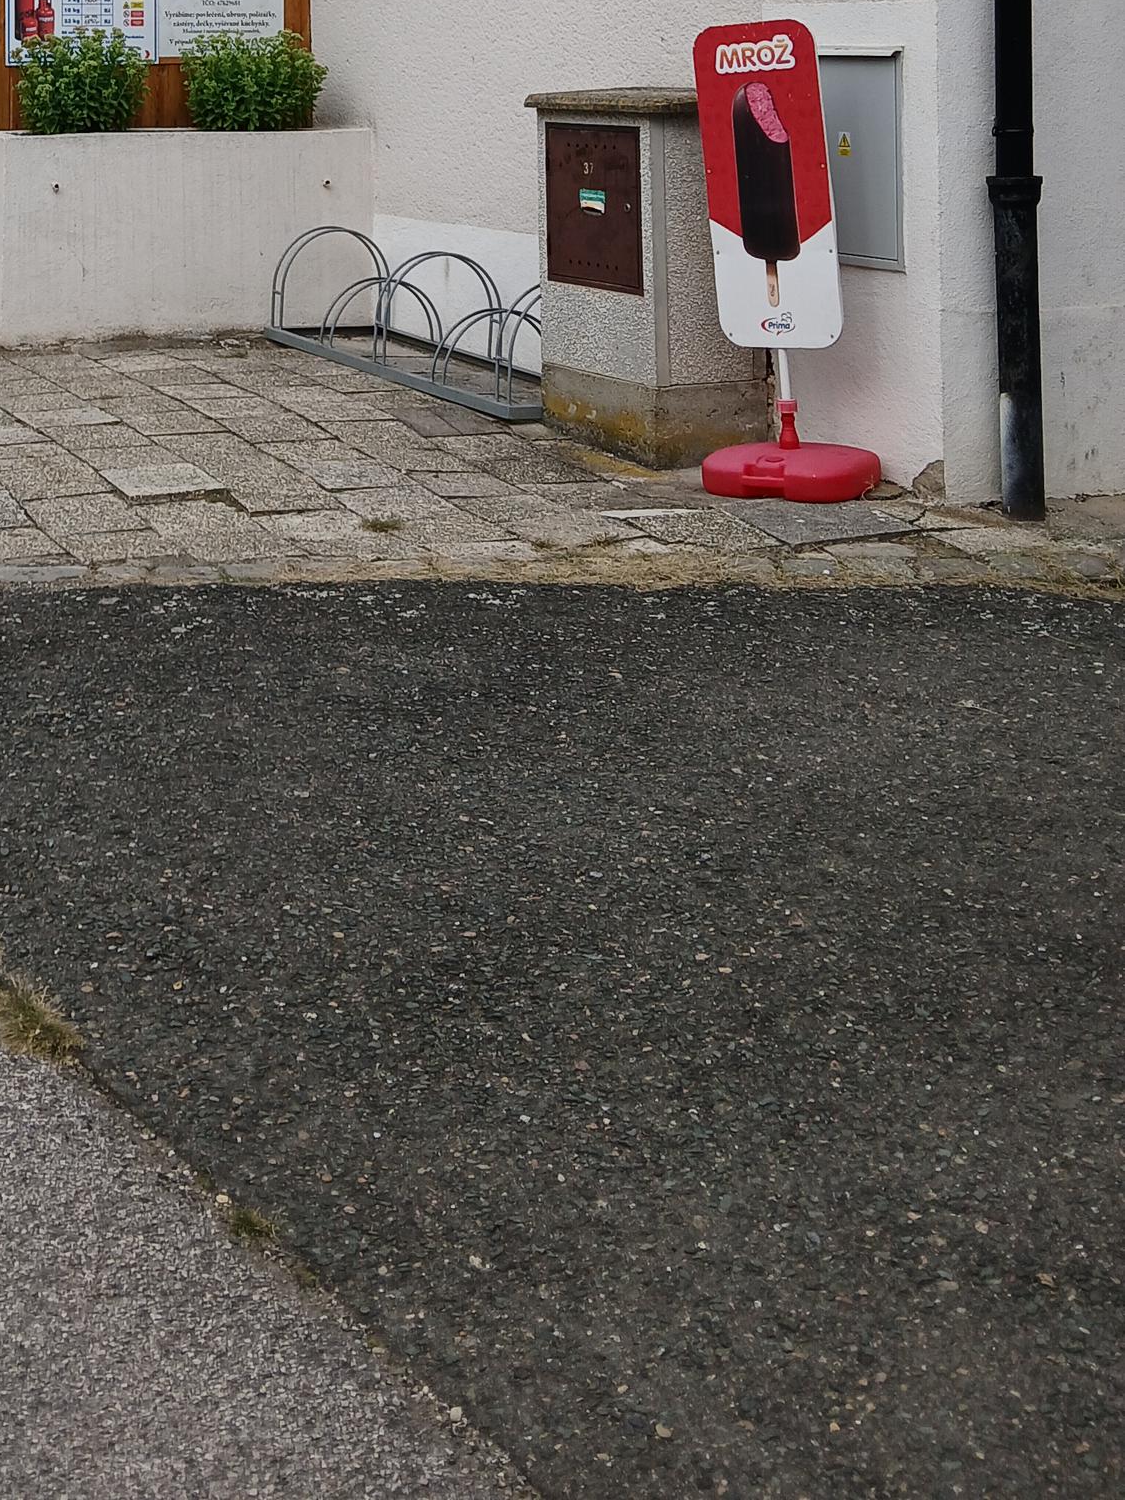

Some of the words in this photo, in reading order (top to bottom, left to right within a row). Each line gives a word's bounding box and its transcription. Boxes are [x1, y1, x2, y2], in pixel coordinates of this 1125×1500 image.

[718, 37, 792, 71] MROŽ
[583, 162, 594, 174] 37
[768, 320, 791, 330] Prima
